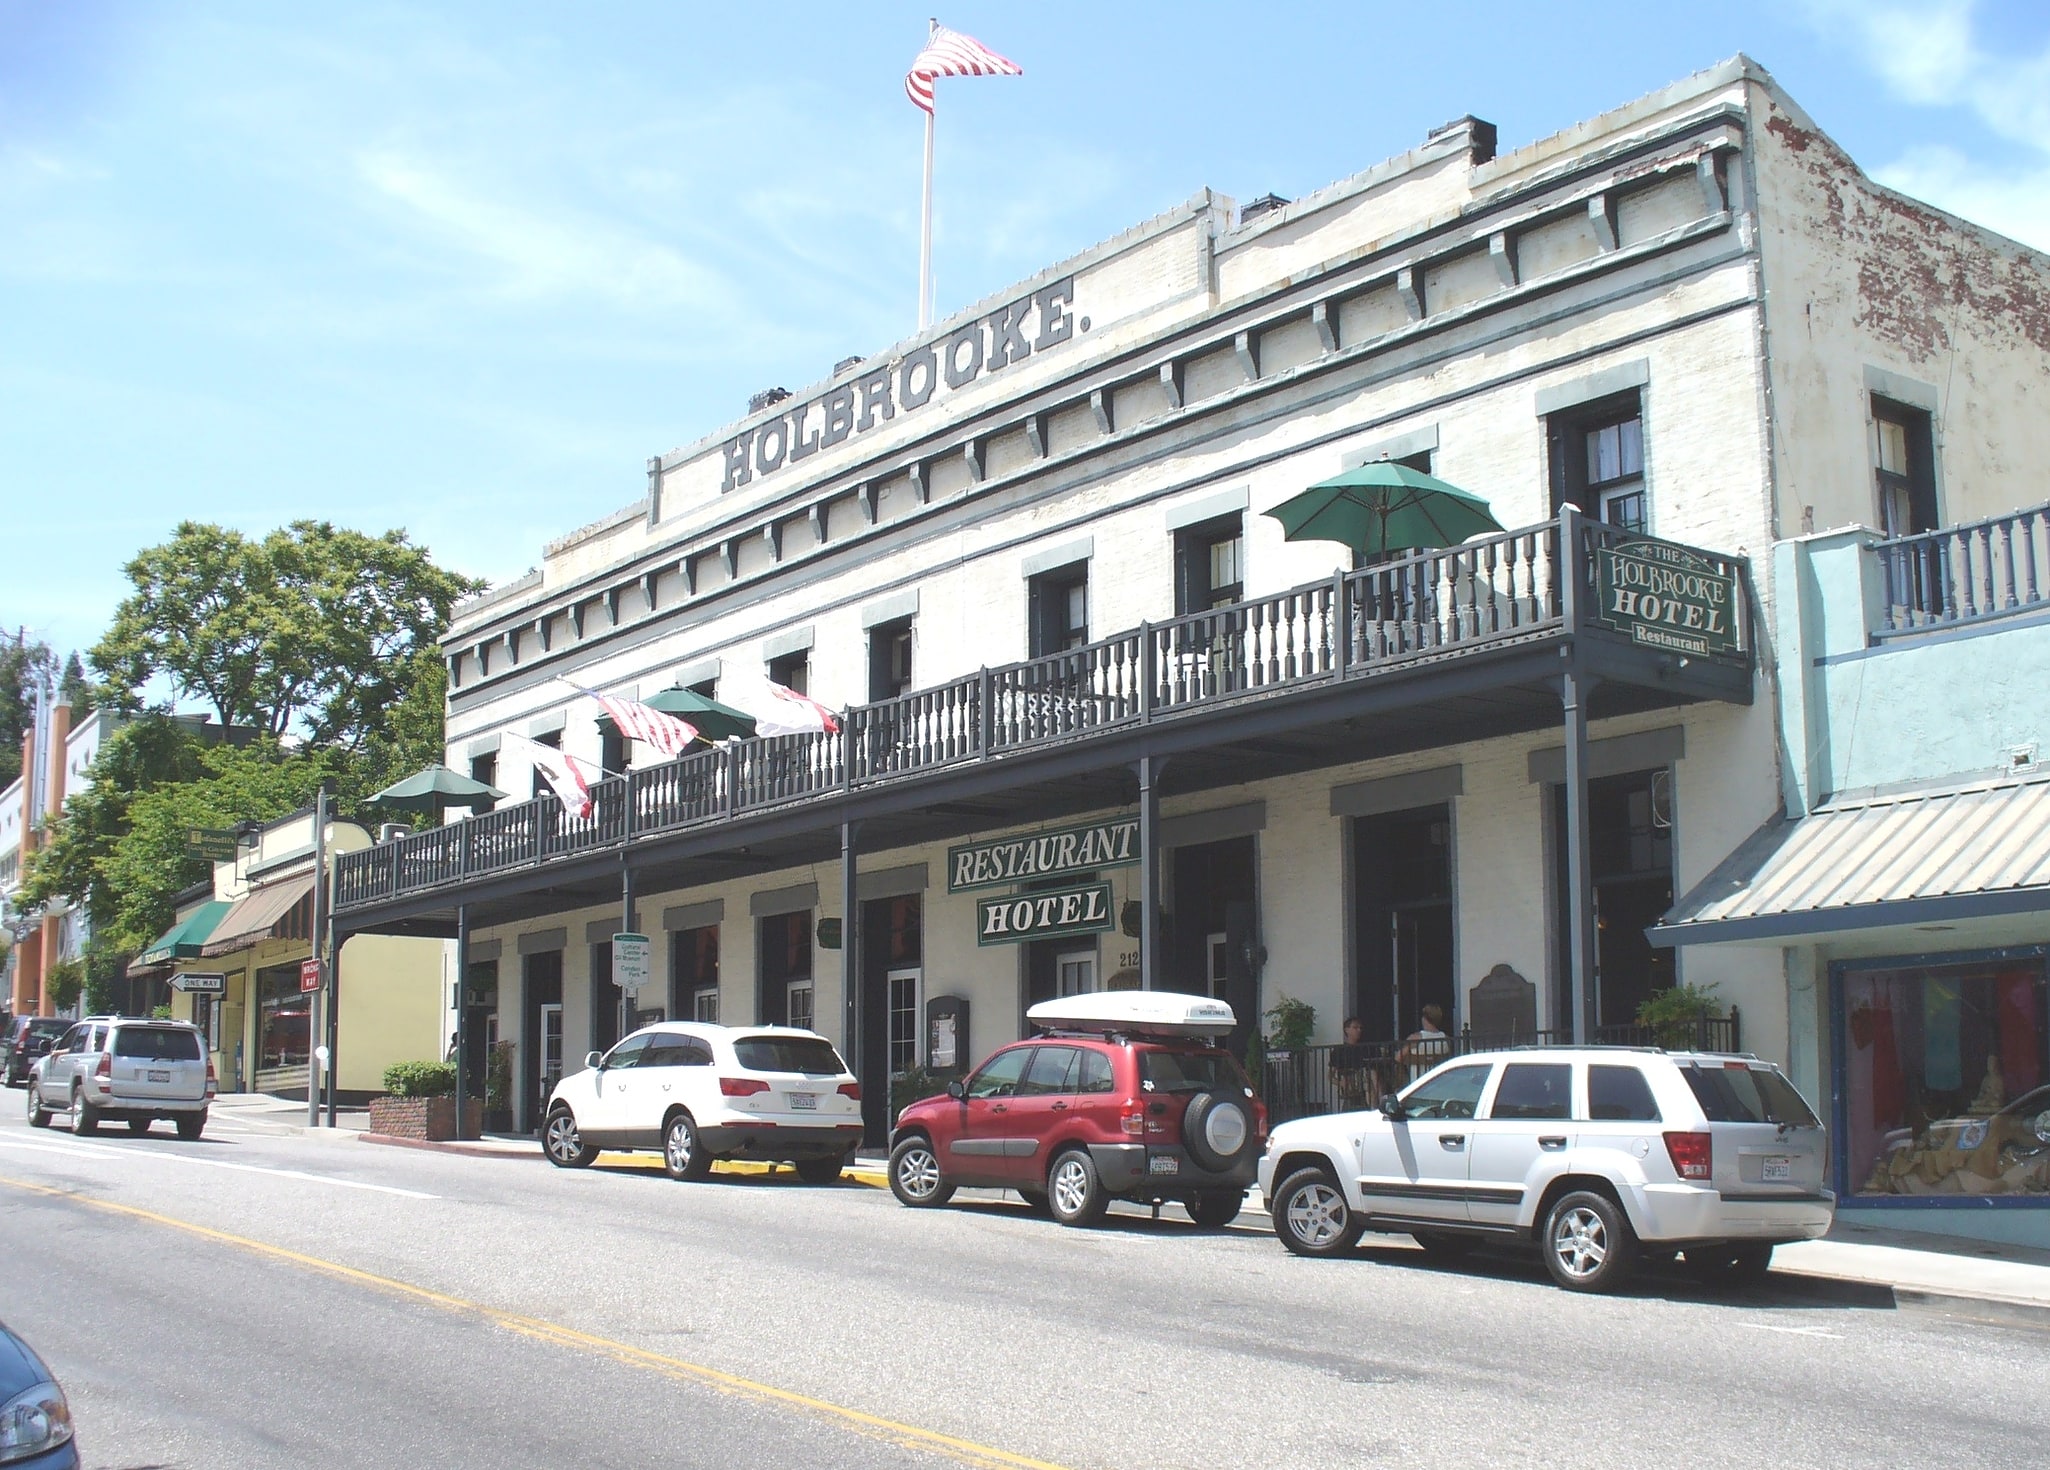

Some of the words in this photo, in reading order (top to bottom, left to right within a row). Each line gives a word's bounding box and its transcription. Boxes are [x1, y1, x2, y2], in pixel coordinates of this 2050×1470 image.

[721, 275, 1091, 493] HOLBROOKE.
[1652, 546, 1681, 563] THE
[1610, 555, 1726, 608] HOLBROOKE
[1611, 587, 1726, 635] HOTEL
[1636, 625, 1706, 653] Restaurant
[953, 821, 1139, 886] RESTAURANT
[983, 890, 1108, 935] HOTEL
[1119, 951, 1140, 968] 212
[184, 979, 201, 987] ONE
[202, 979, 218, 987] WAY
[305, 976, 317, 987] WAY
